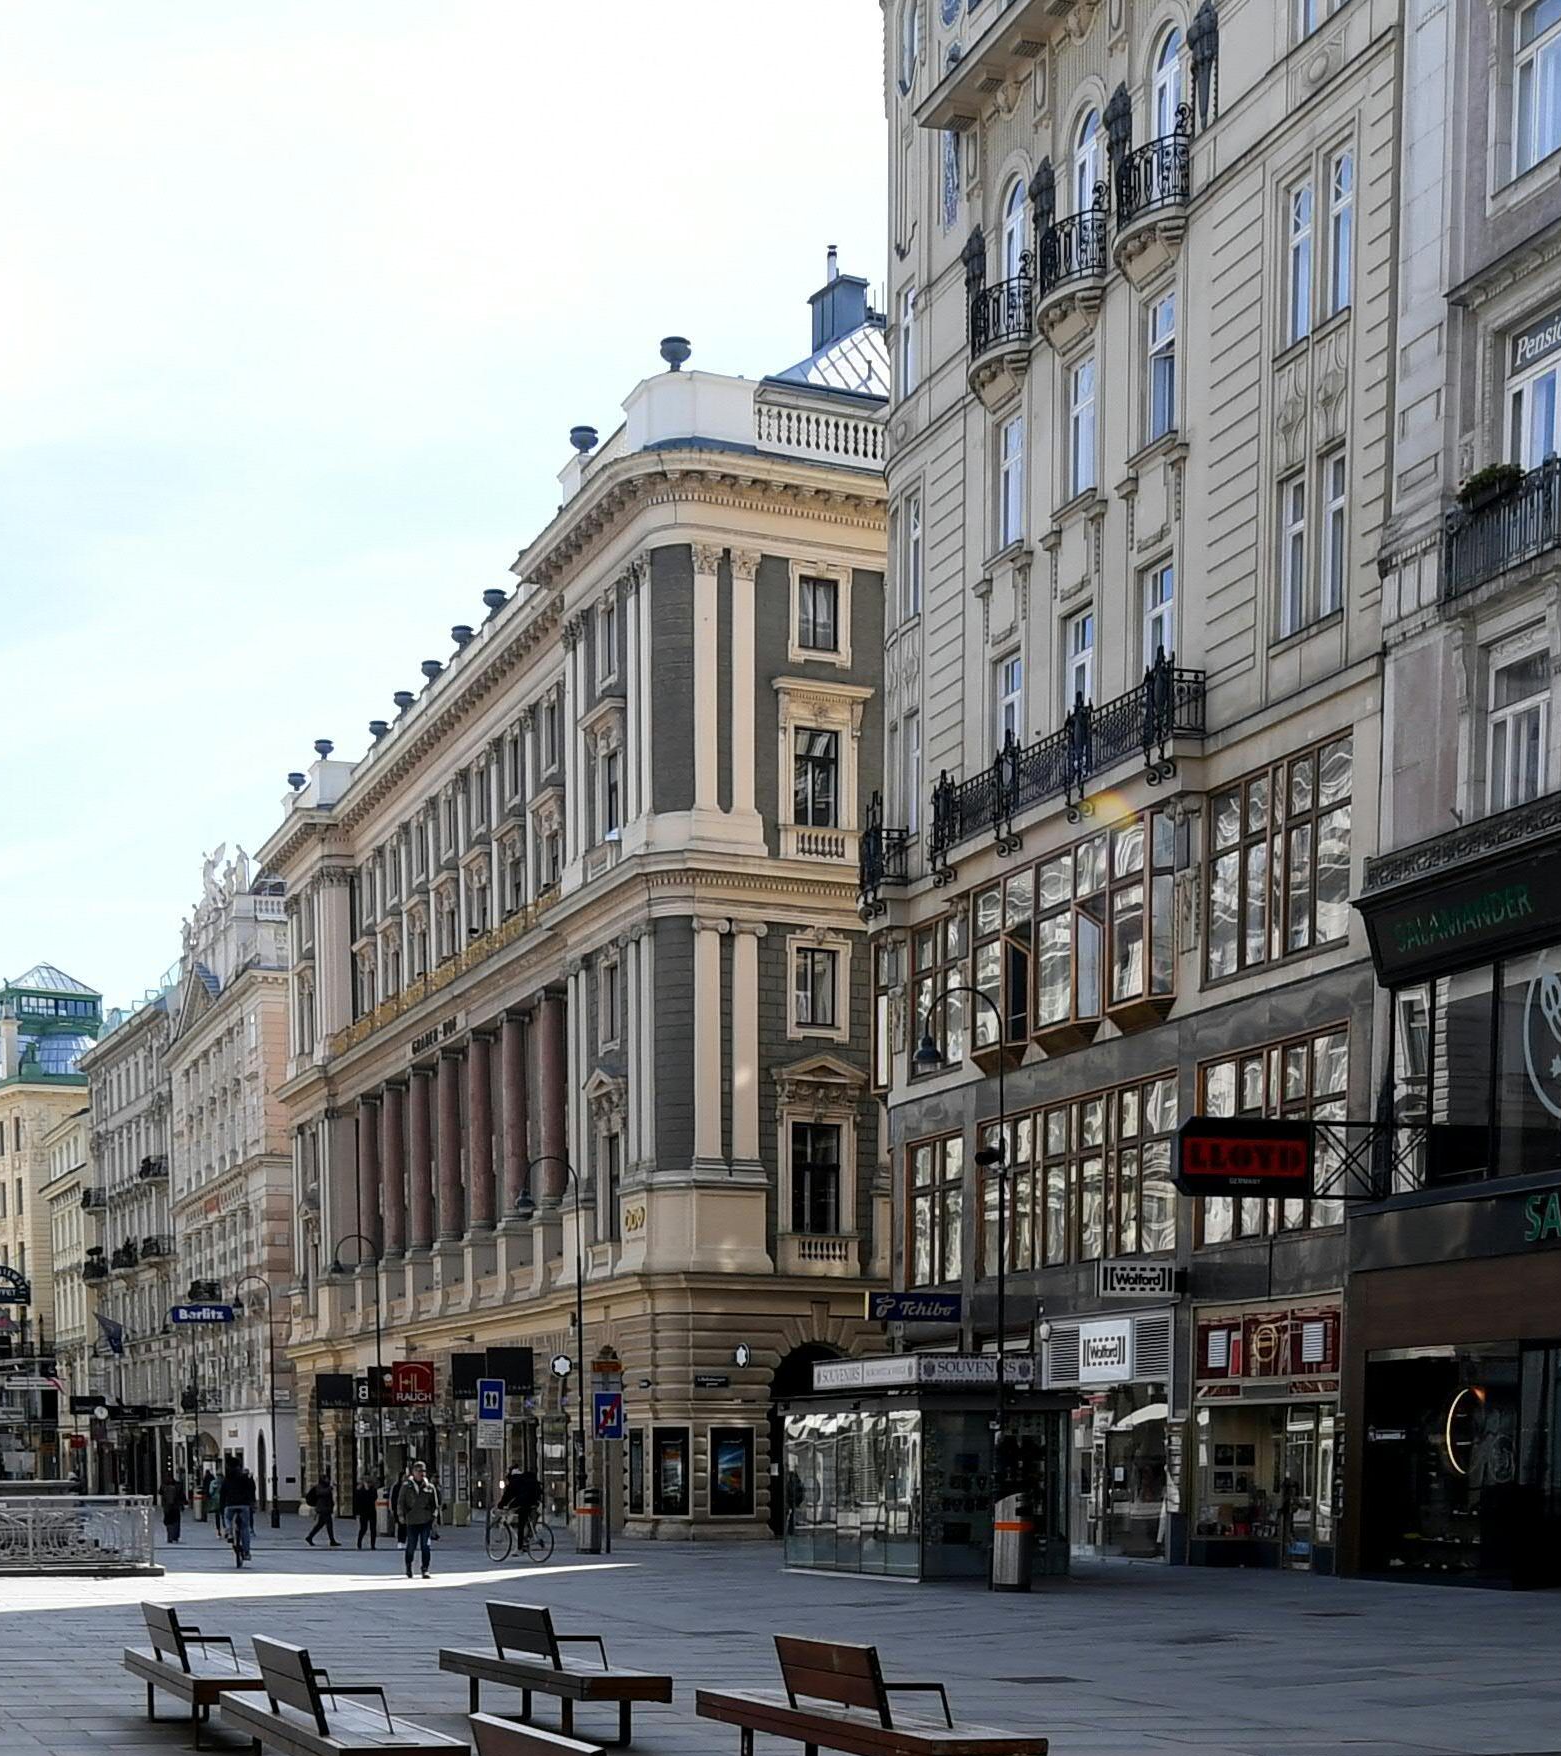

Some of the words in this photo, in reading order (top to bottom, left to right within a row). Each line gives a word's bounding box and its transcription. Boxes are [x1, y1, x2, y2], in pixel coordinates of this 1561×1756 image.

[1115, 1272, 1161, 1286] Wolford
[900, 1301, 956, 1316] Tchibo
[939, 1360, 1016, 1374] SOUVENRS
[396, 1392, 432, 1401] RAUCH
